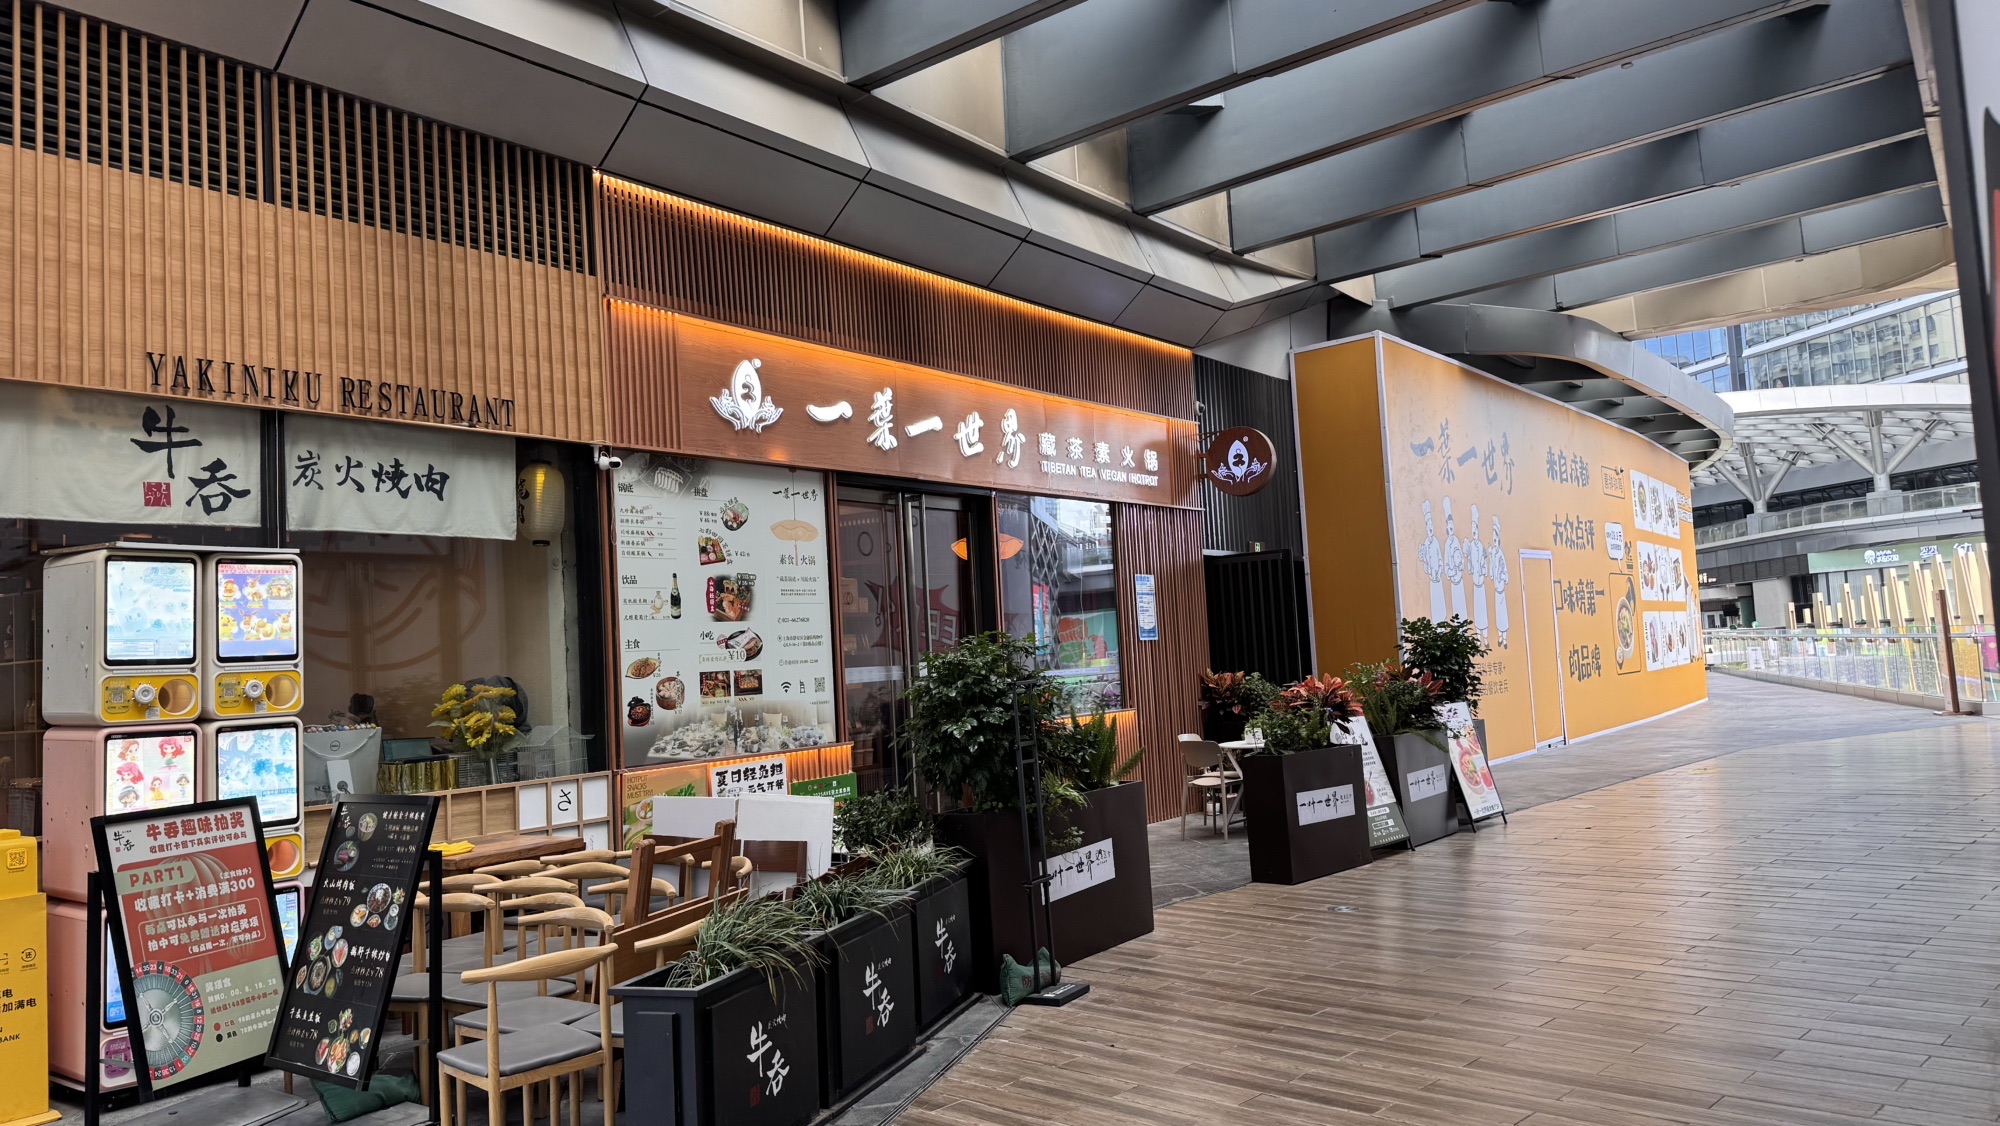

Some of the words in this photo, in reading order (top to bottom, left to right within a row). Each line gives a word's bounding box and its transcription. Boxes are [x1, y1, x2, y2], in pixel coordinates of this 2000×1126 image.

[146, 351, 322, 405] YAKINIKU
[341, 376, 515, 428] RESTAURANT
[1038, 432, 1160, 472] 藏茶素火锅
[1041, 460, 1077, 476] TIBETAN
[1080, 465, 1097, 478] TEA
[1099, 468, 1127, 483] VEGAN
[1129, 472, 1158, 486] HOTPOT
[1546, 446, 1590, 488] 来自成都
[618, 483, 634, 493] 锅底
[693, 487, 708, 498] 拼盘
[1552, 514, 1595, 551] 大众点评
[622, 575, 638, 585] 饮品
[1554, 579, 1605, 617] 口味榜第一
[625, 639, 641, 650] 主食
[700, 630, 715, 641] 小吃
[728, 650, 746, 662] ¥10
[1569, 644, 1603, 683] 的品牌
[627, 775, 648, 783] HOTPOT
[715, 763, 784, 787] 夏日轻负担
[627, 783, 648, 791] SNACKS
[627, 791, 639, 800] MUST
[146, 811, 245, 842] 牛吞趣味抽奖
[129, 865, 185, 888] PART1
[134, 877, 256, 912] 收藏打卡+消费满300
